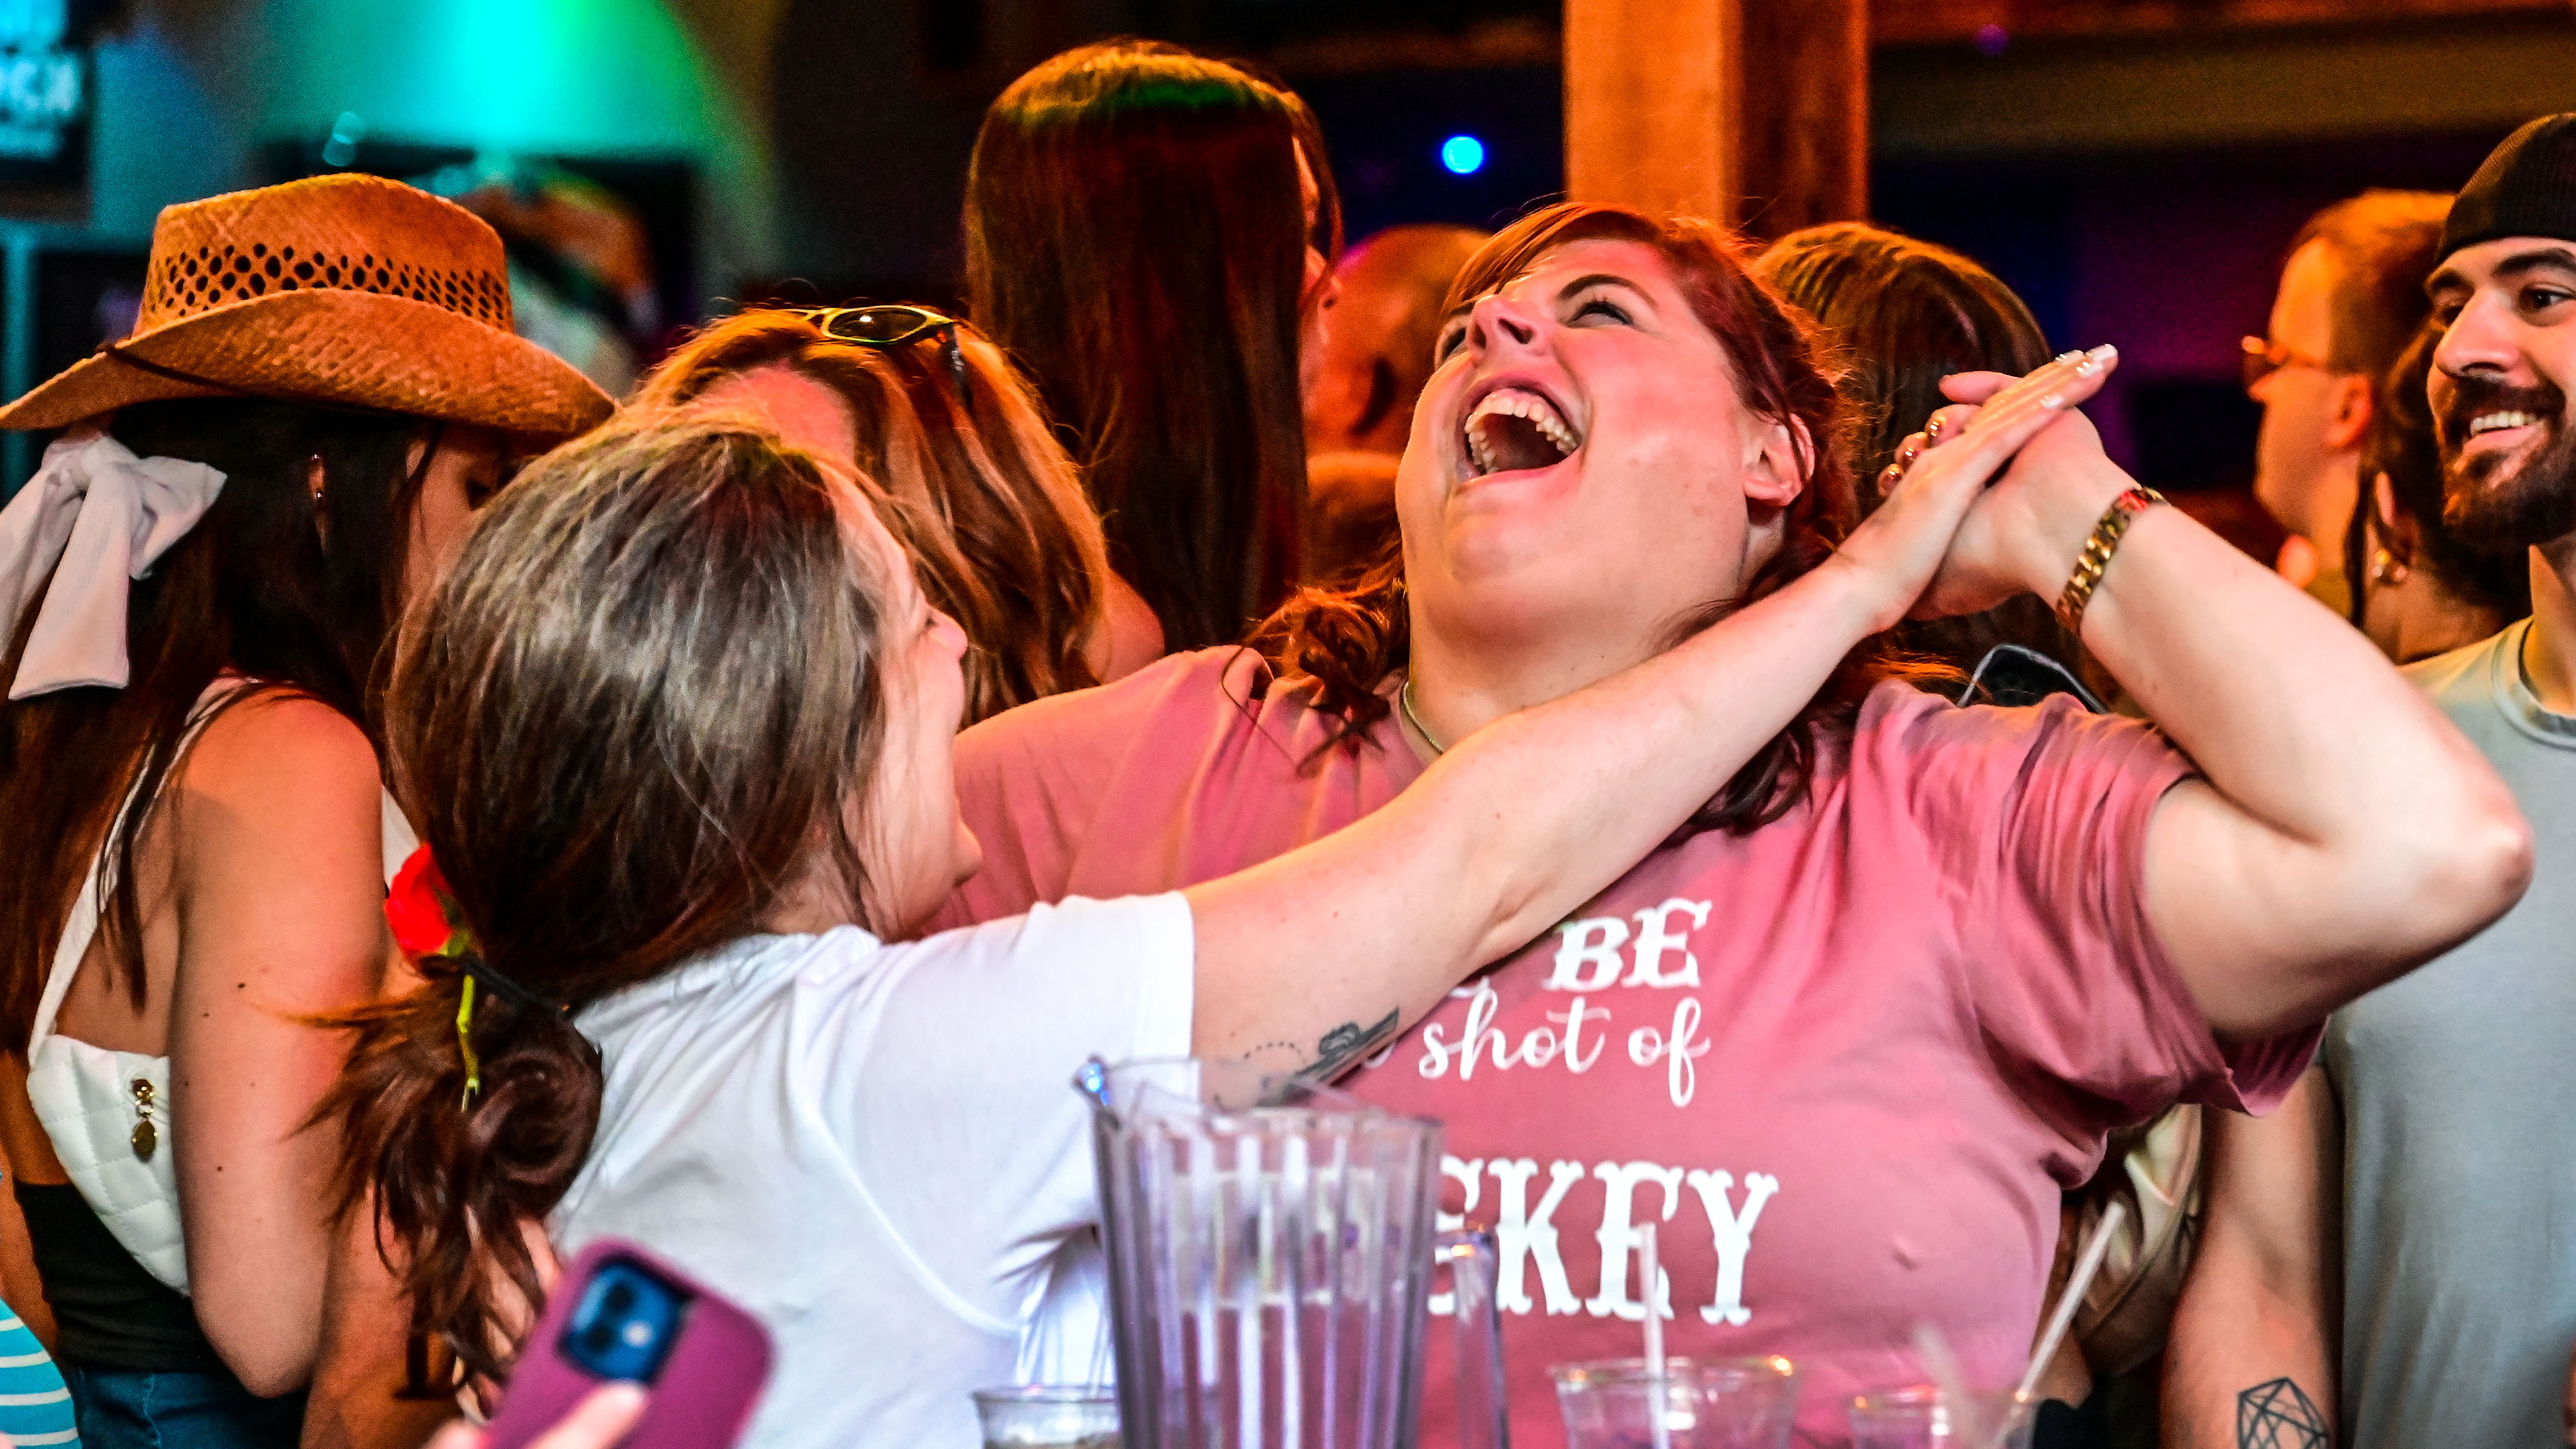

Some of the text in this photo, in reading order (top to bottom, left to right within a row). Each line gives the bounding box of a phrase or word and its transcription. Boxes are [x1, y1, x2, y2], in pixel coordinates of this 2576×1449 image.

[1542, 897, 1713, 992] BE
[1418, 989, 1711, 1109] shot of
